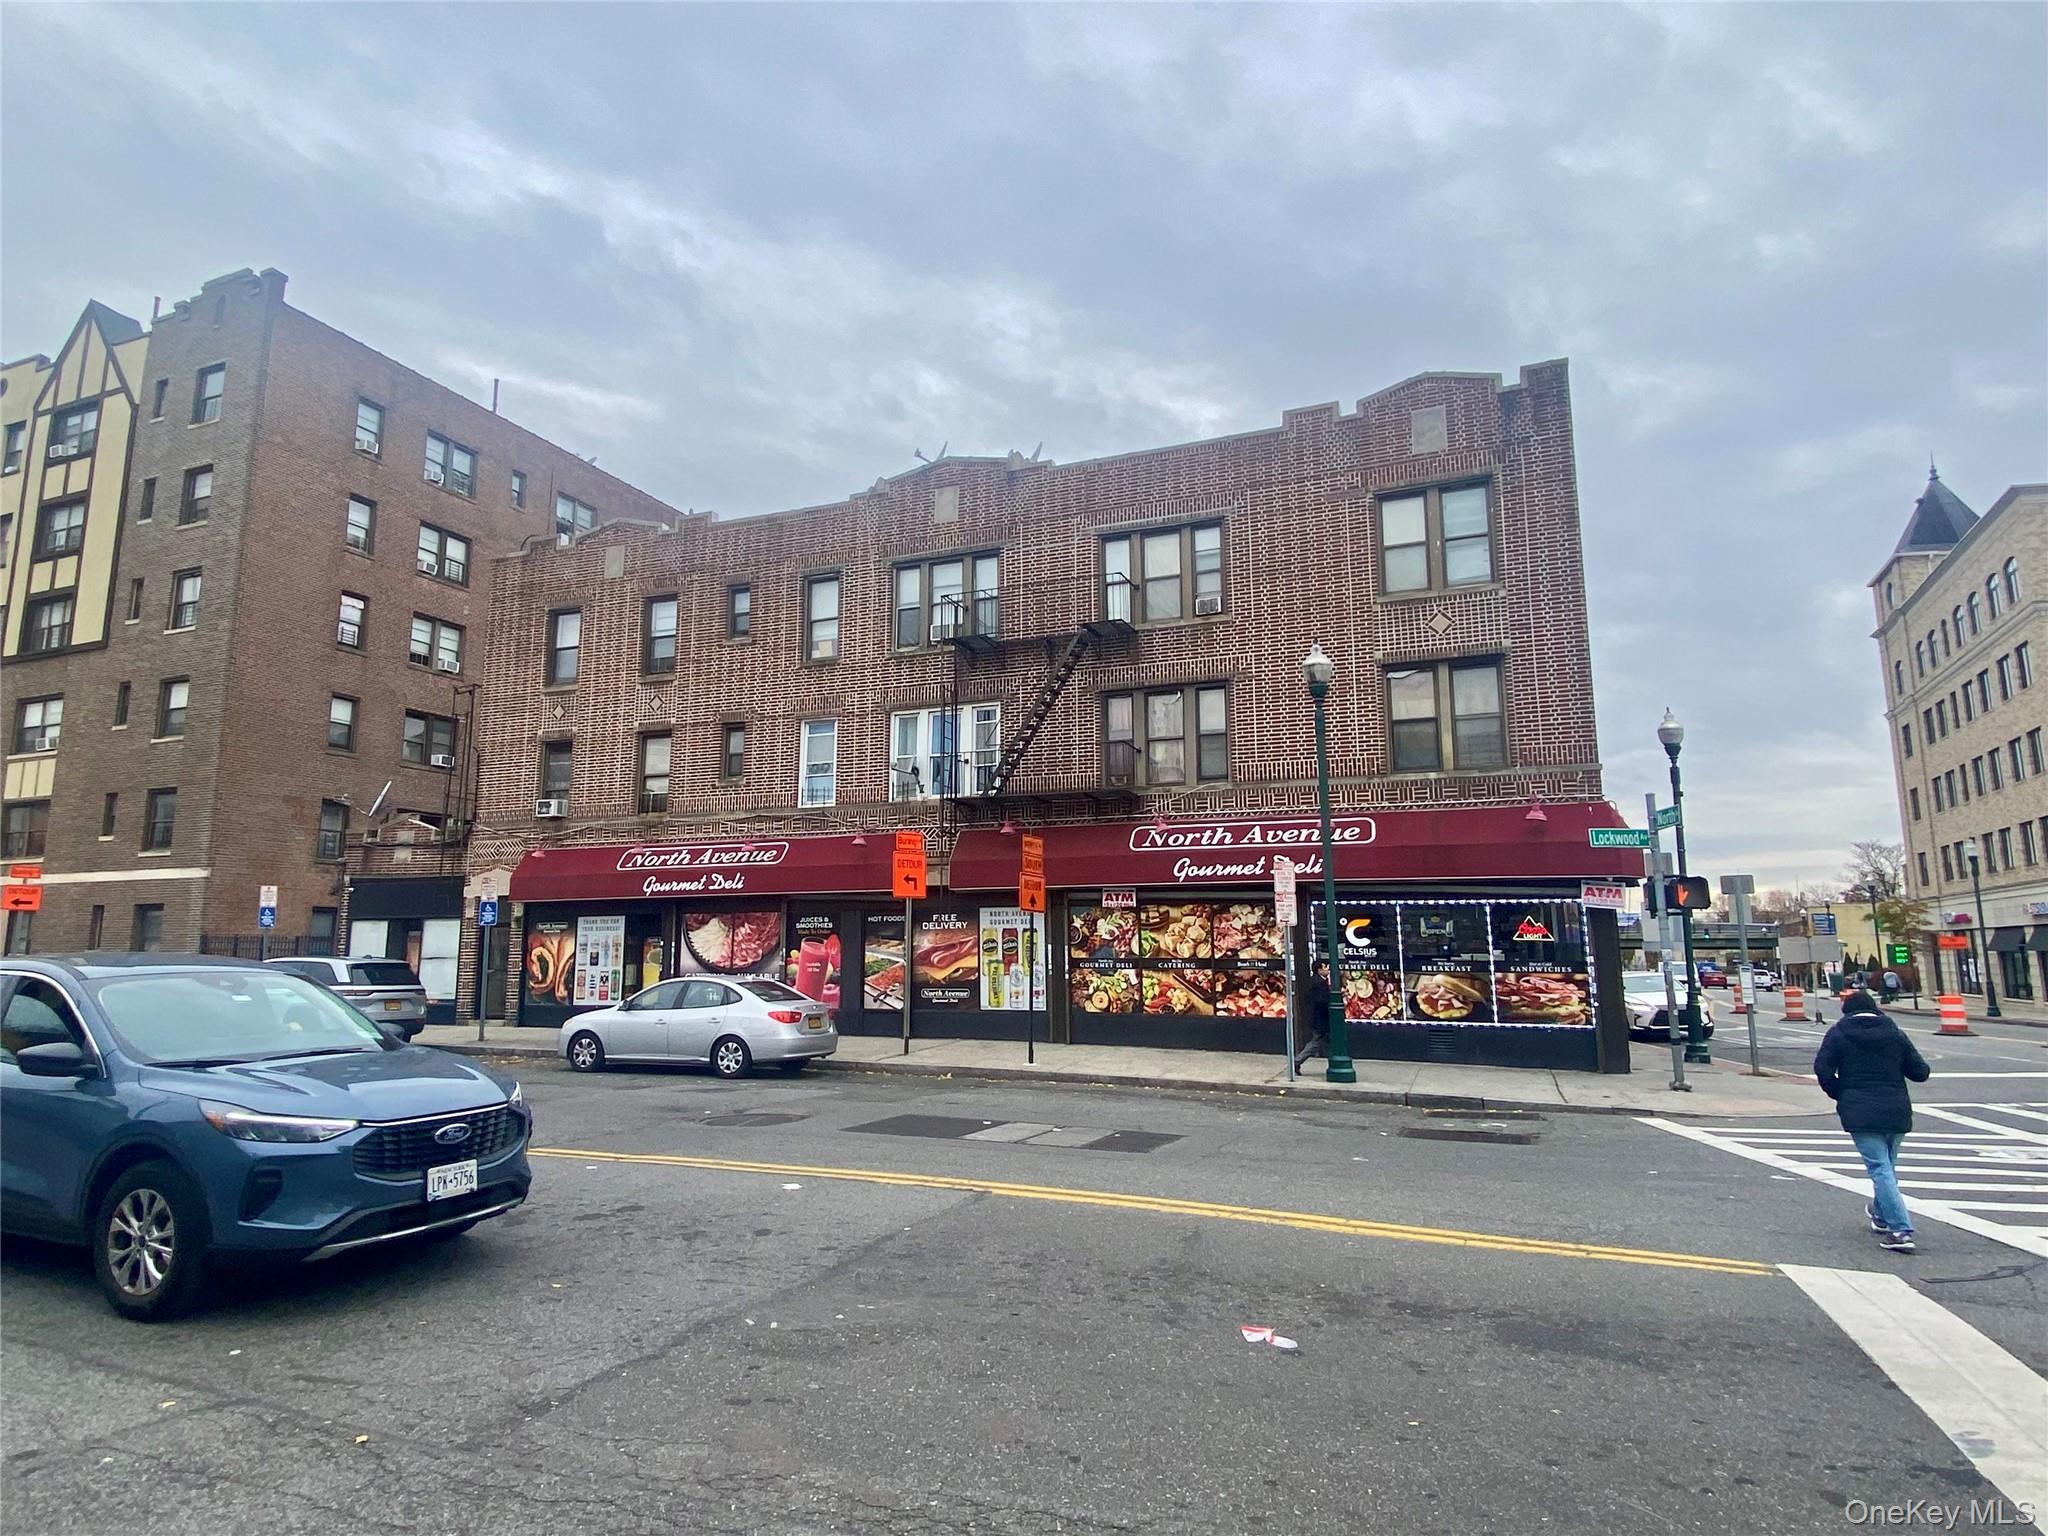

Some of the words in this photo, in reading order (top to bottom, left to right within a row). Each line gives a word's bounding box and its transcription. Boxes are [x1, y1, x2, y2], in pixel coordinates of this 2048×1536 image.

[1142, 828, 1234, 847] North
[1240, 825, 1361, 844] Avenue
[1592, 830, 1640, 845] Lockwood
[625, 849, 689, 868] North
[693, 849, 777, 864] Avenue
[897, 858, 923, 869] DETOUR
[1173, 856, 1266, 883] Gourmet
[643, 875, 706, 896] Gourmet
[709, 872, 744, 890] Deli
[1104, 893, 1133, 902] ATM
[1584, 887, 1622, 899] ATM
[922, 921, 968, 930] DELIVERY
[1343, 947, 1377, 956] CELSIUS
[923, 989, 943, 997] North
